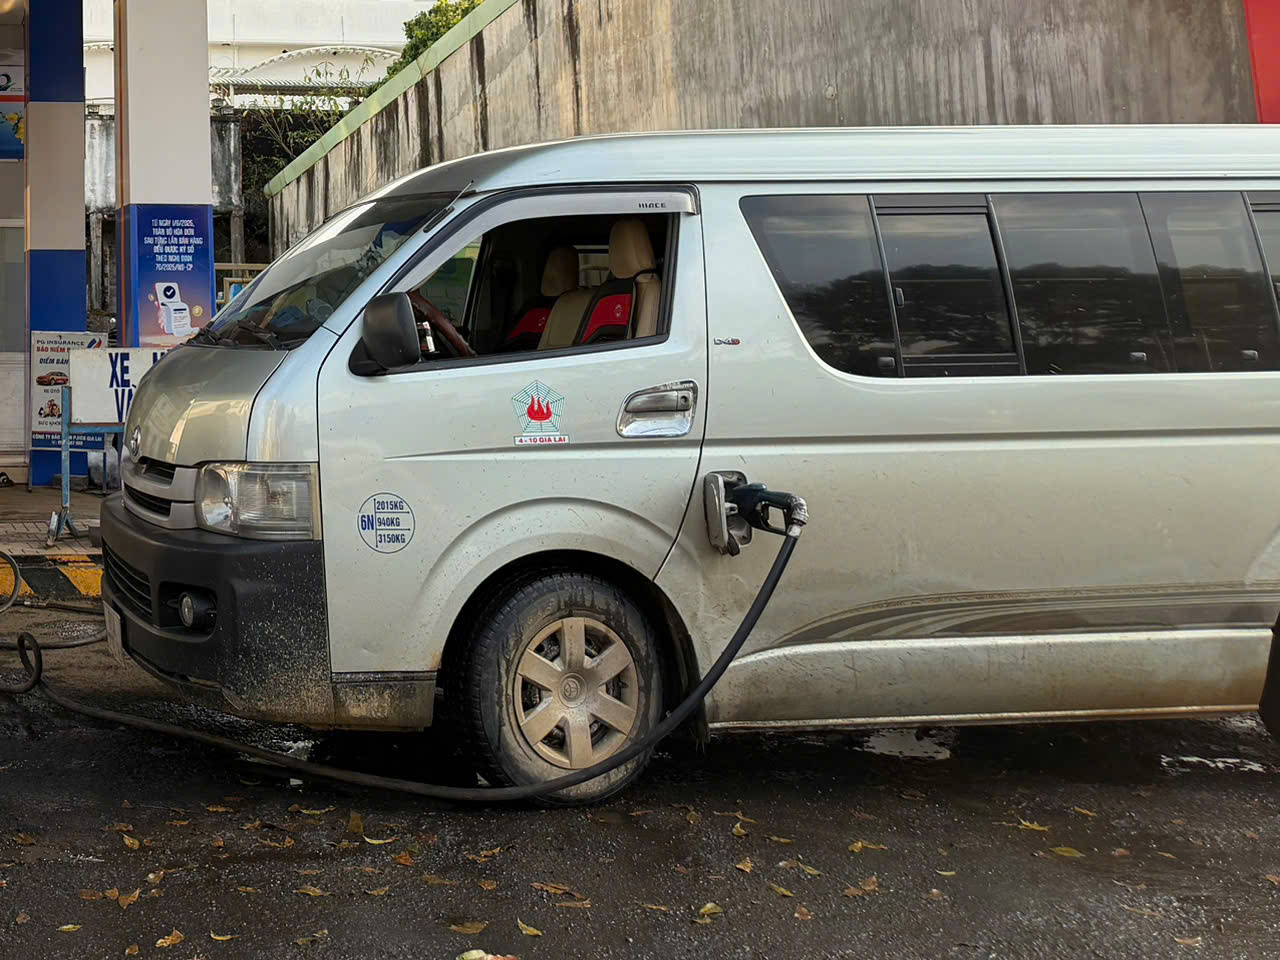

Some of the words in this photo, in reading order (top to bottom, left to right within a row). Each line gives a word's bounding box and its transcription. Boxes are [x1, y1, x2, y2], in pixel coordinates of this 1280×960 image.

[109, 352, 130, 388] XE
[376, 500, 404, 511] 2015KG
[360, 514, 374, 531] 6N
[377, 516, 400, 528] 940KG
[378, 533, 406, 544] 3150KG
